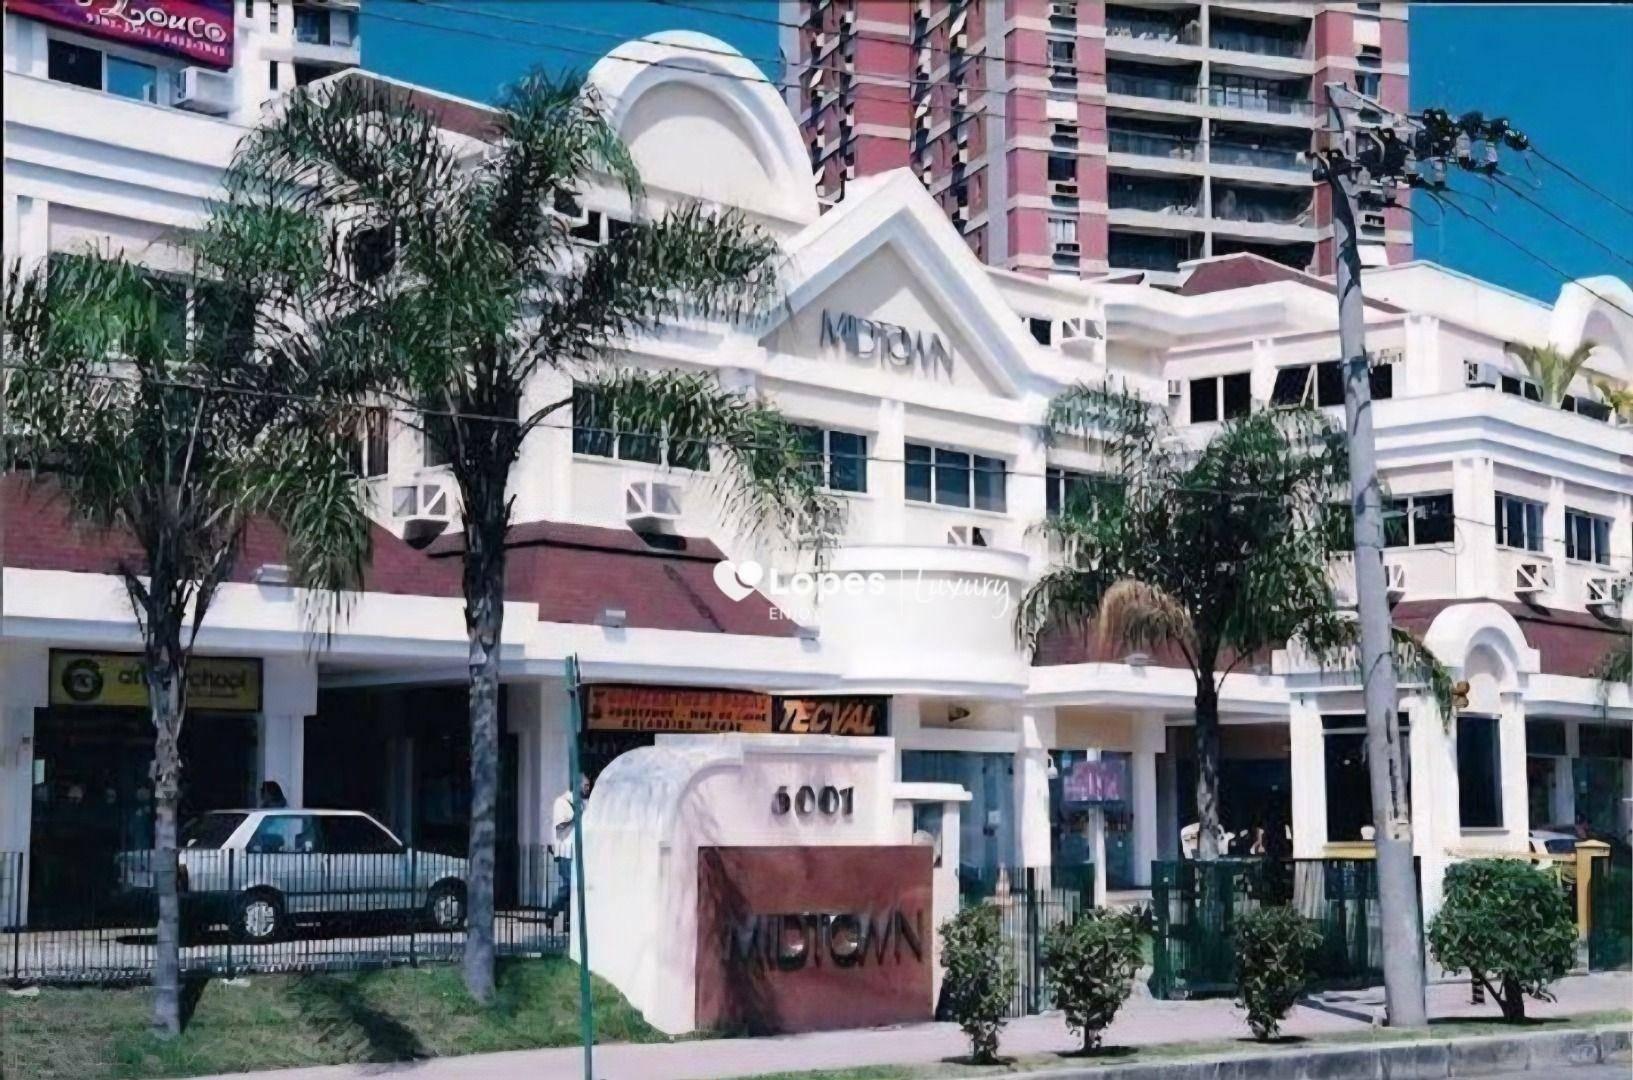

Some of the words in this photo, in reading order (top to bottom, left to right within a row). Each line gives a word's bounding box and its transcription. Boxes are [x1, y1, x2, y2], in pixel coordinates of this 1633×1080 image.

[819, 308, 956, 383] MIDTOWN
[188, 667, 247, 691] chool
[778, 698, 876, 735] TECVAL
[770, 785, 854, 819] 6001
[719, 906, 923, 971] MIDTOWN
